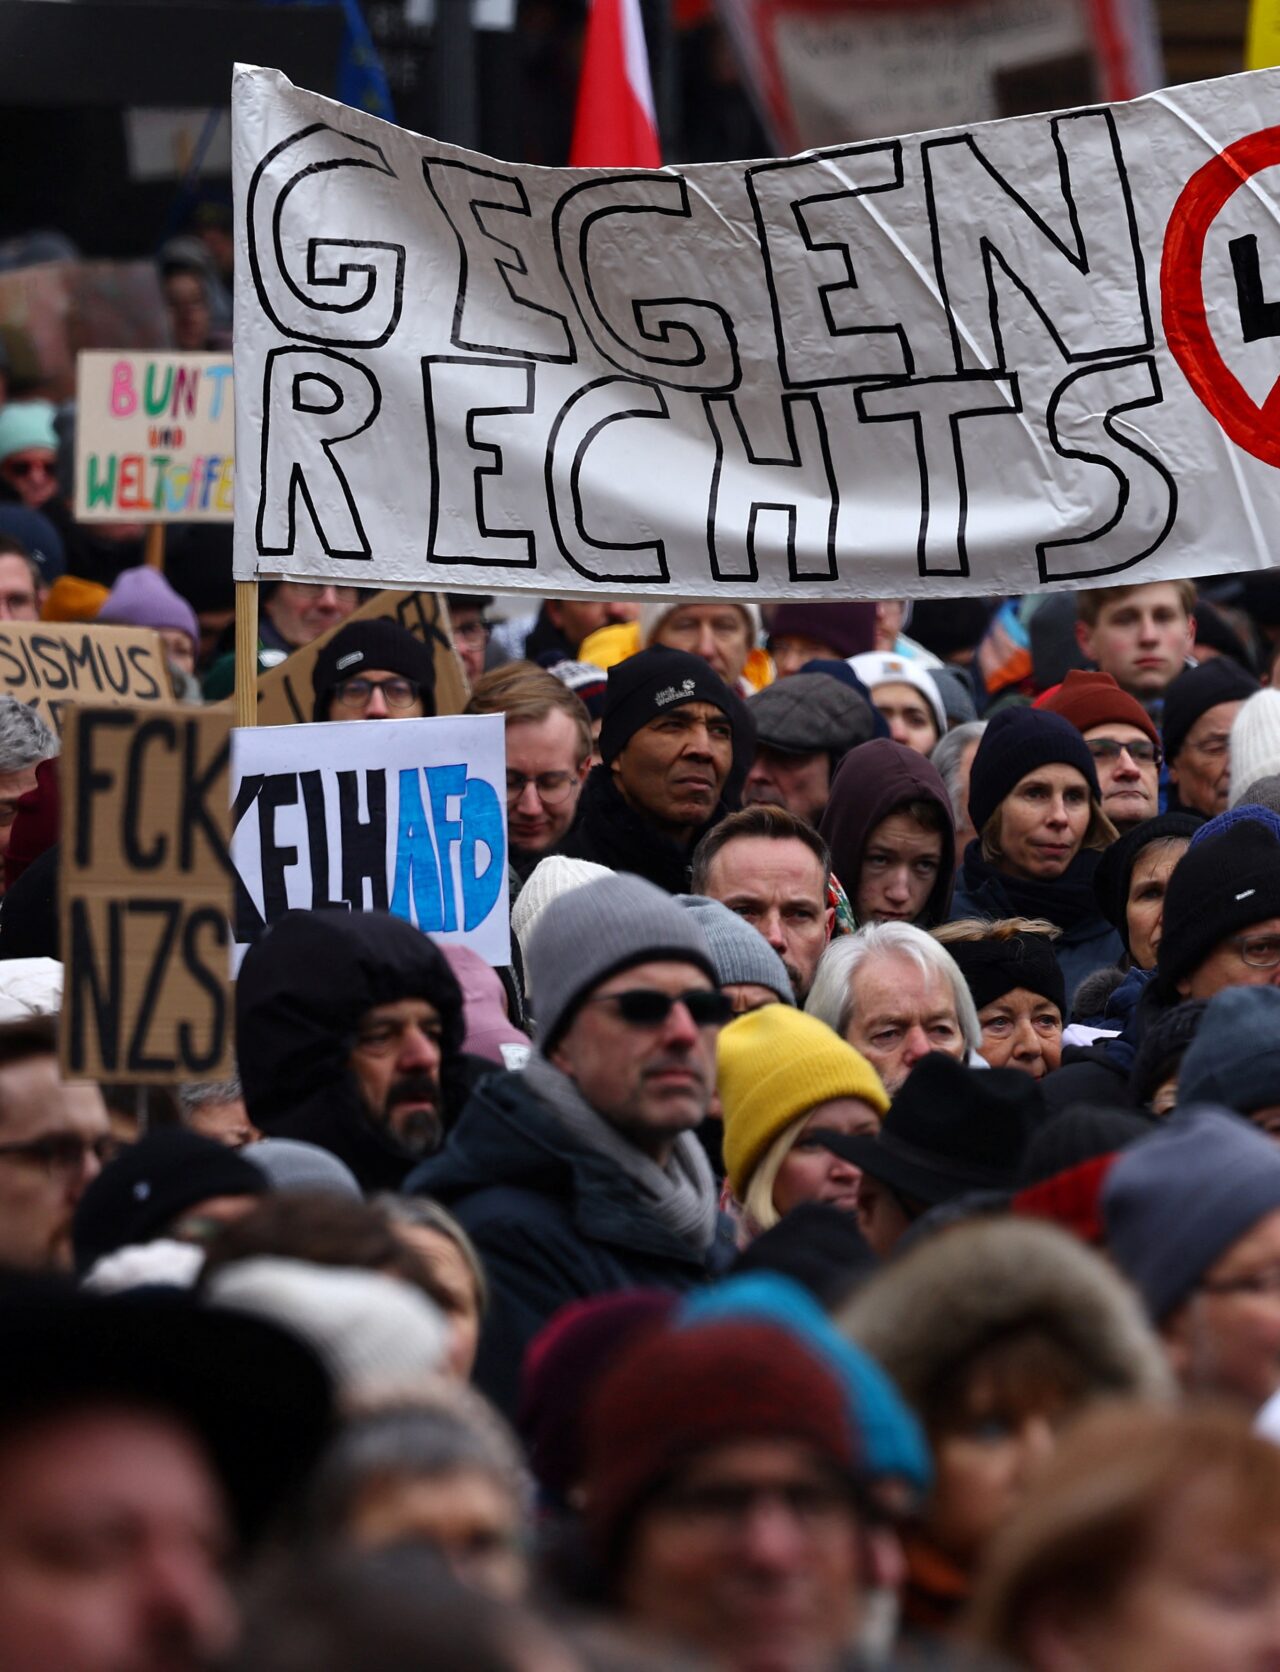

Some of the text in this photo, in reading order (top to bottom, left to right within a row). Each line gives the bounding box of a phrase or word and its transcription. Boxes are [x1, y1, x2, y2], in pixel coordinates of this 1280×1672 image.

[247, 108, 1155, 393] GEGEN
[110, 360, 233, 421] BUNT
[256, 346, 1179, 583] RECHTS
[73, 709, 234, 874] FCK
[68, 897, 228, 1074] NZS
